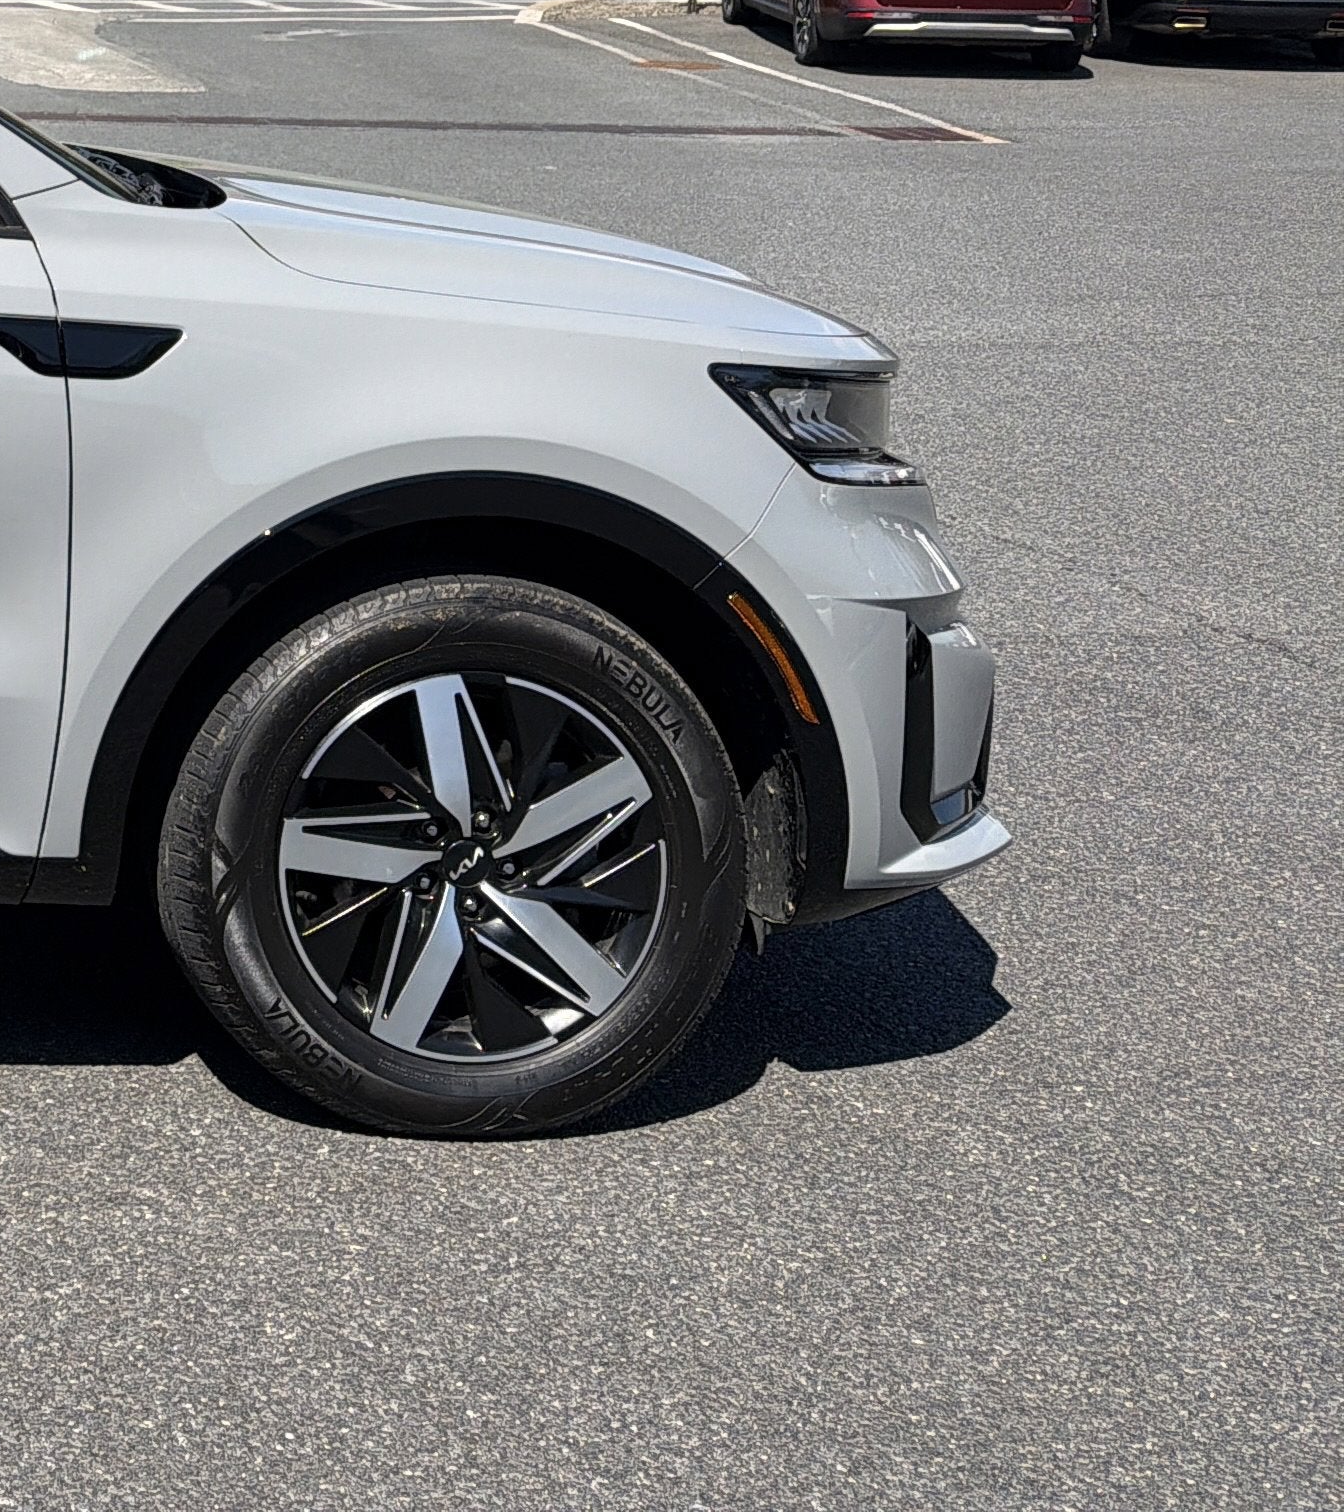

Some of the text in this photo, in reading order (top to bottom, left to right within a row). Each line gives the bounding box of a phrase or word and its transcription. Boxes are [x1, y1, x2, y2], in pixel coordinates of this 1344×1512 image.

[593, 645, 684, 745] NEBULA
[449, 846, 485, 881] KIA
[264, 996, 363, 1092] NEBULA
